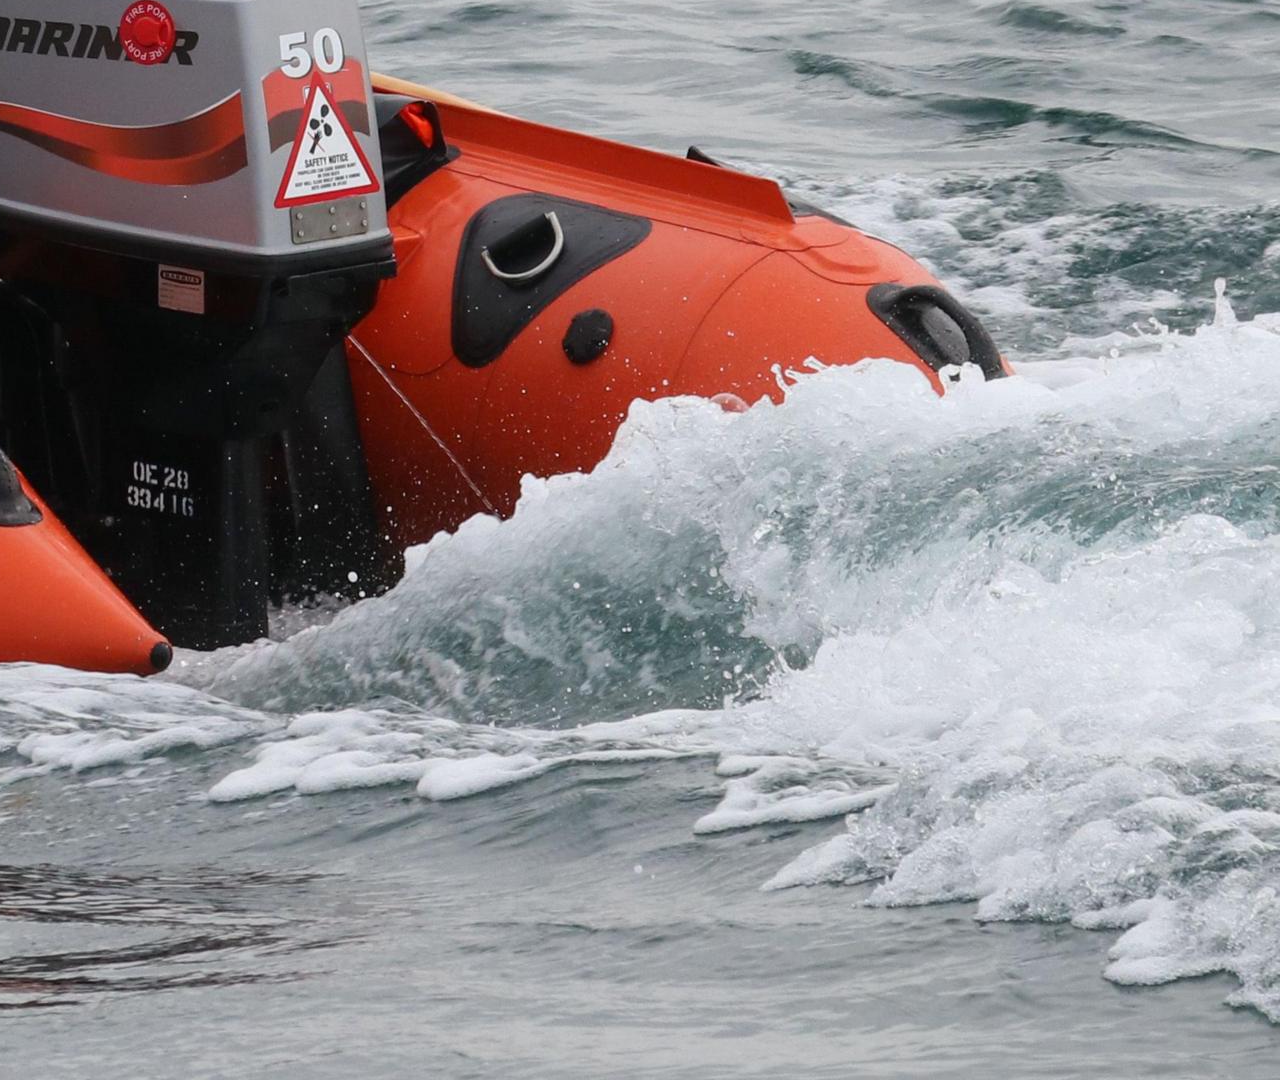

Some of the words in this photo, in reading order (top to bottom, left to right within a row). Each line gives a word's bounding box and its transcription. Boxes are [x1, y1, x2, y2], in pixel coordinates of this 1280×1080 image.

[125, 5, 145, 24] FIRE
[279, 27, 345, 79] 50
[304, 156, 327, 168] SAFETY
[328, 153, 349, 165] NOTICE
[163, 467, 189, 490] 28
